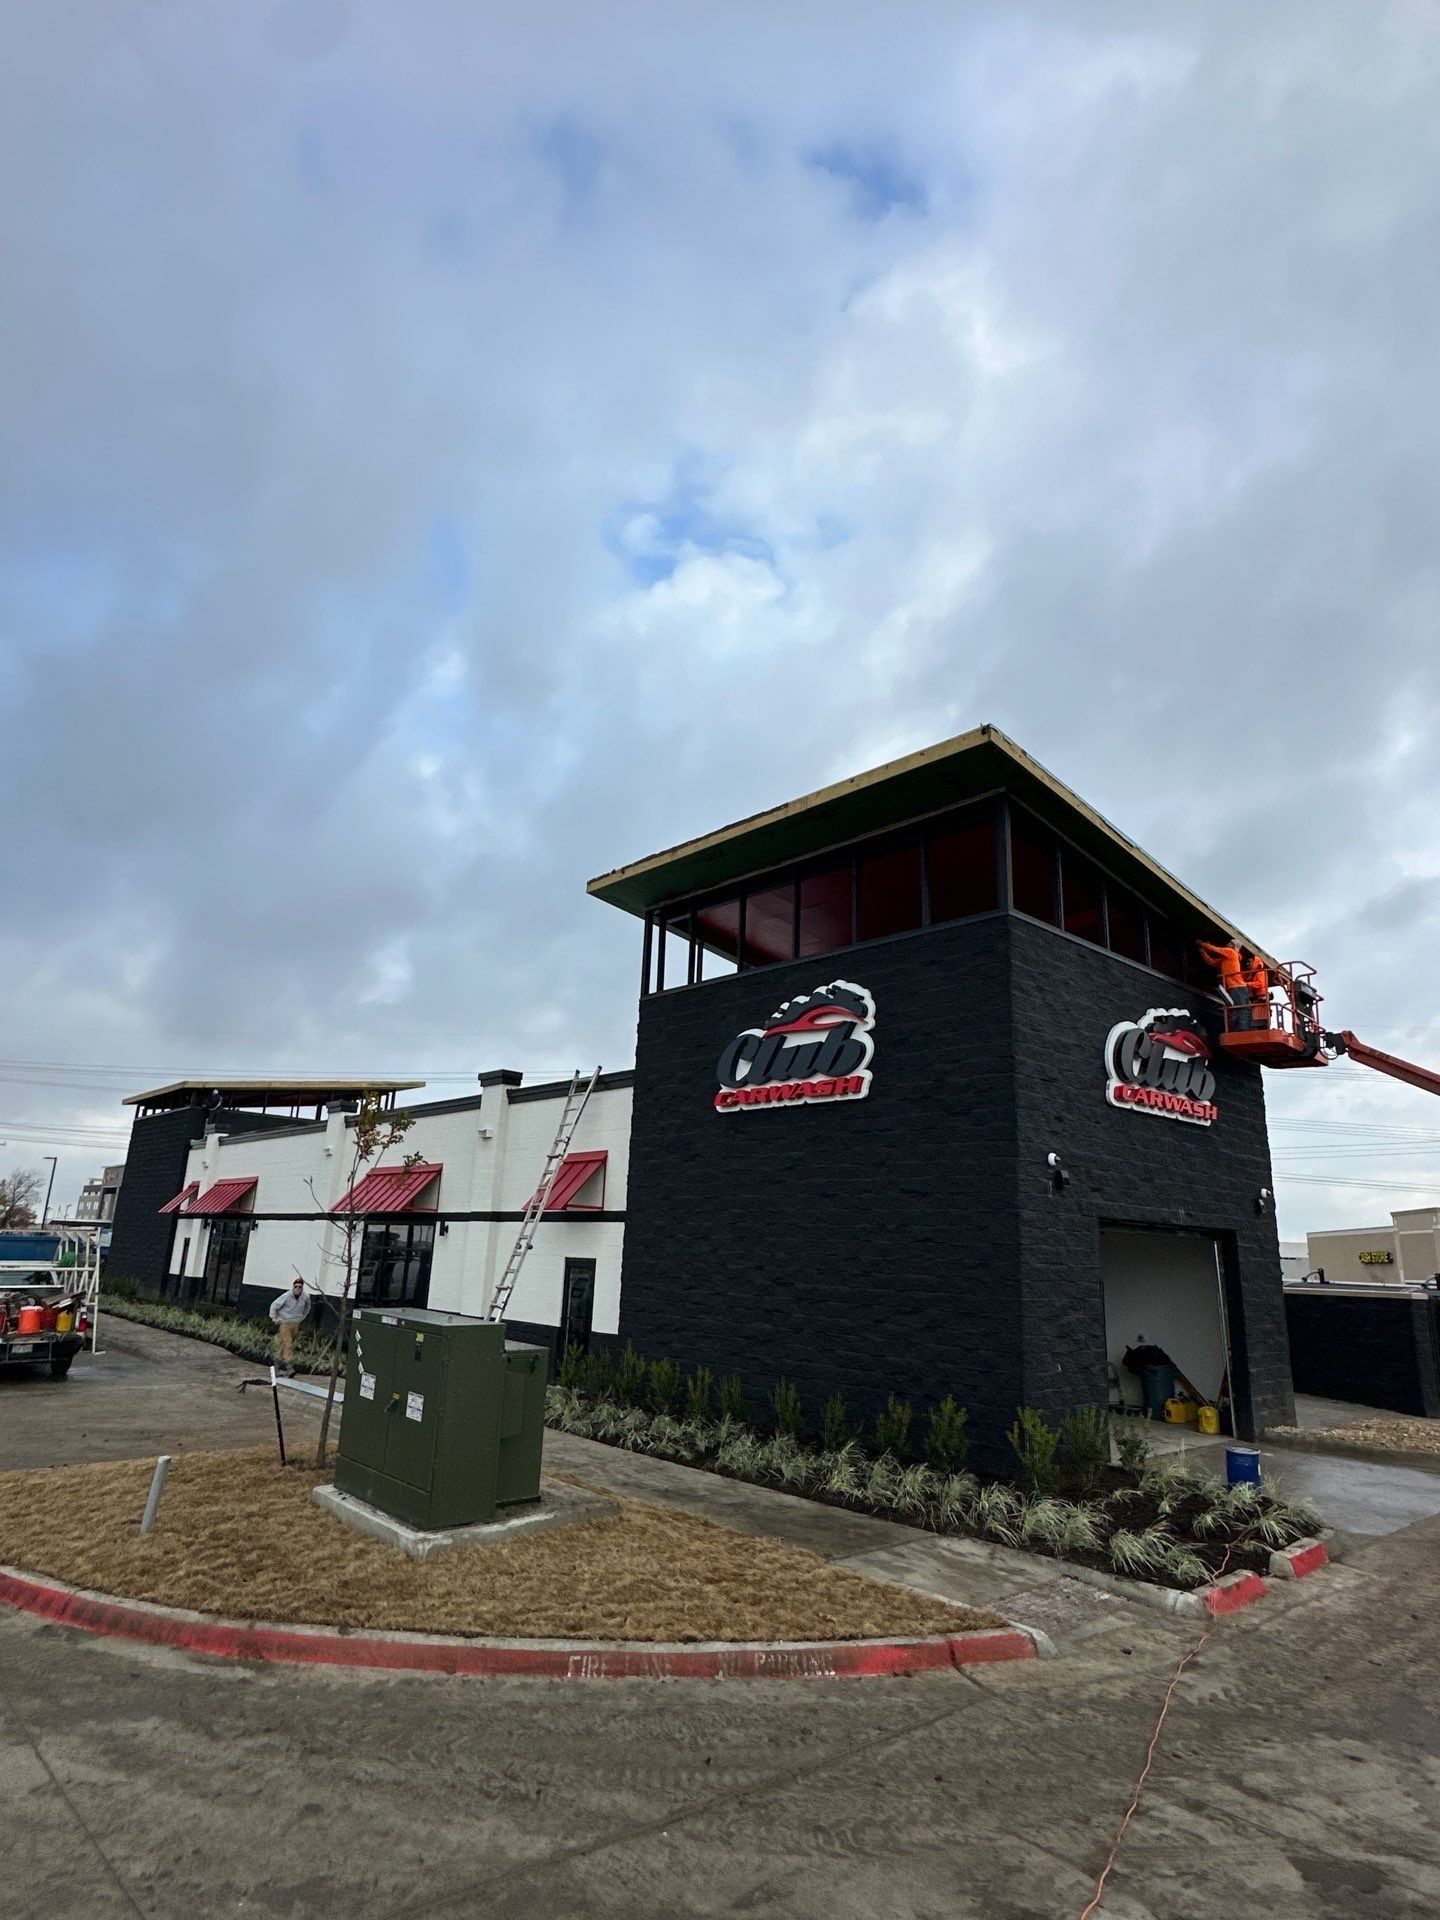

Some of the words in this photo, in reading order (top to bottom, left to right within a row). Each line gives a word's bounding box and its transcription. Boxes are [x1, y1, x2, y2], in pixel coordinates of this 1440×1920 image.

[717, 1021, 867, 1088] Club
[1113, 1028, 1216, 1101] Club
[714, 1076, 865, 1107] CARWASH
[1114, 1084, 1219, 1120] CARWASH
